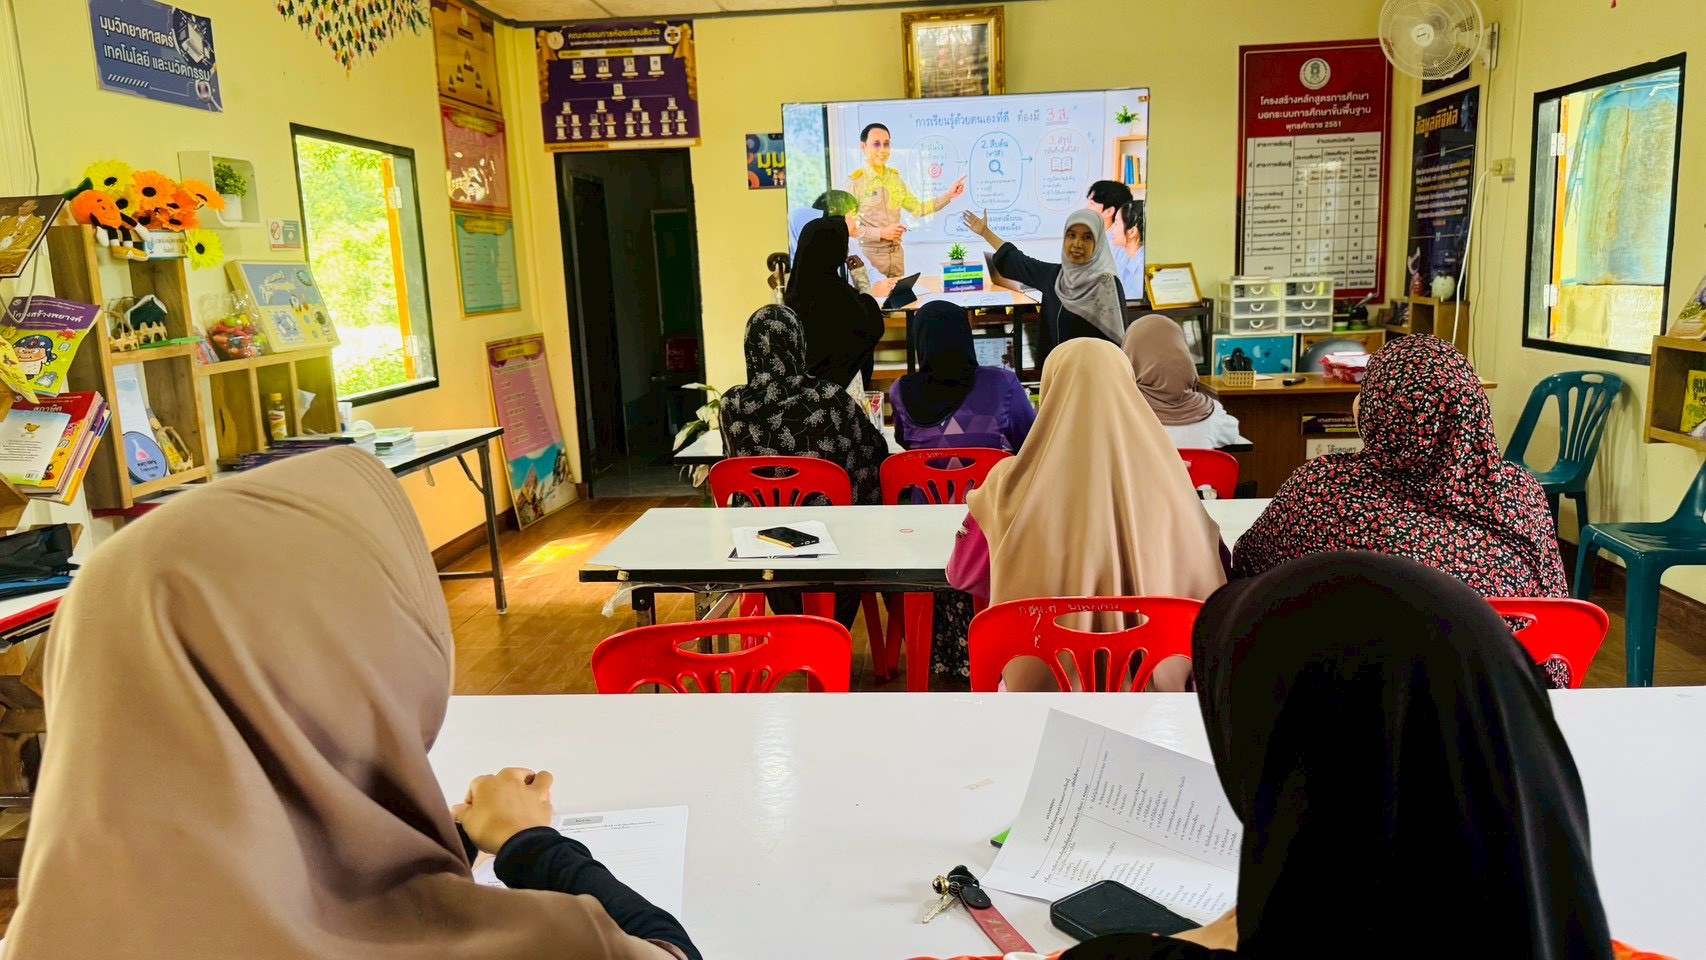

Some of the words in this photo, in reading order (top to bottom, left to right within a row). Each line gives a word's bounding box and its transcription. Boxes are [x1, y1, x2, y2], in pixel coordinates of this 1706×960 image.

[99, 15, 175, 48] มุมวิทยาศาสตร์
[103, 43, 150, 67] เทคโนโลยี
[152, 56, 211, 81] และนวัตกรรม
[1260, 92, 1369, 106] โครงสร้างหลักสูตรการศึกษา
[915, 111, 1010, 129] การเรียนรู้ด้วยตนเองที่ดี
[1016, 109, 1040, 123] ต้องมี
[1046, 107, 1056, 121] 3
[1257, 103, 1371, 120] นอกระบบการศึกษาขั้นพื้นฐาน
[1324, 120, 1342, 128] 2551
[12, 309, 84, 323] โคงสร้างพยางค์
